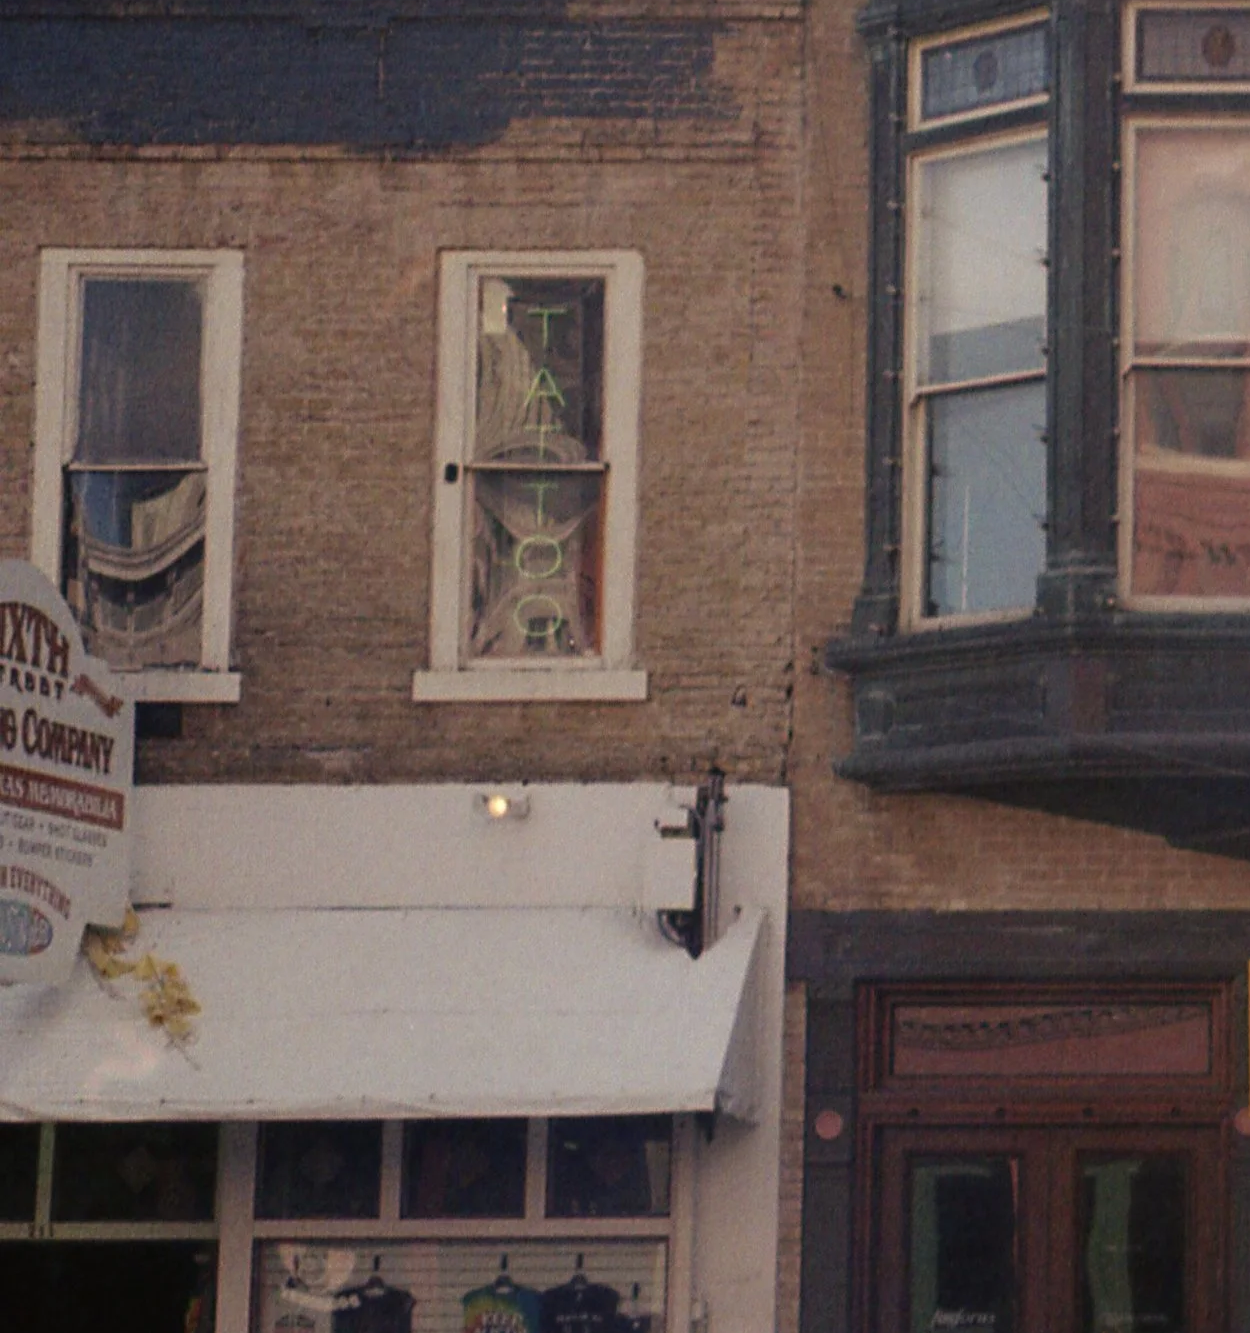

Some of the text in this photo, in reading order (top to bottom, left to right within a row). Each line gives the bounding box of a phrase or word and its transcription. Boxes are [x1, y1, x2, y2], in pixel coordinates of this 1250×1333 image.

[512, 308, 569, 638] TATTOO
[0, 666, 65, 700] REET
[22, 708, 114, 774] COMPANY
